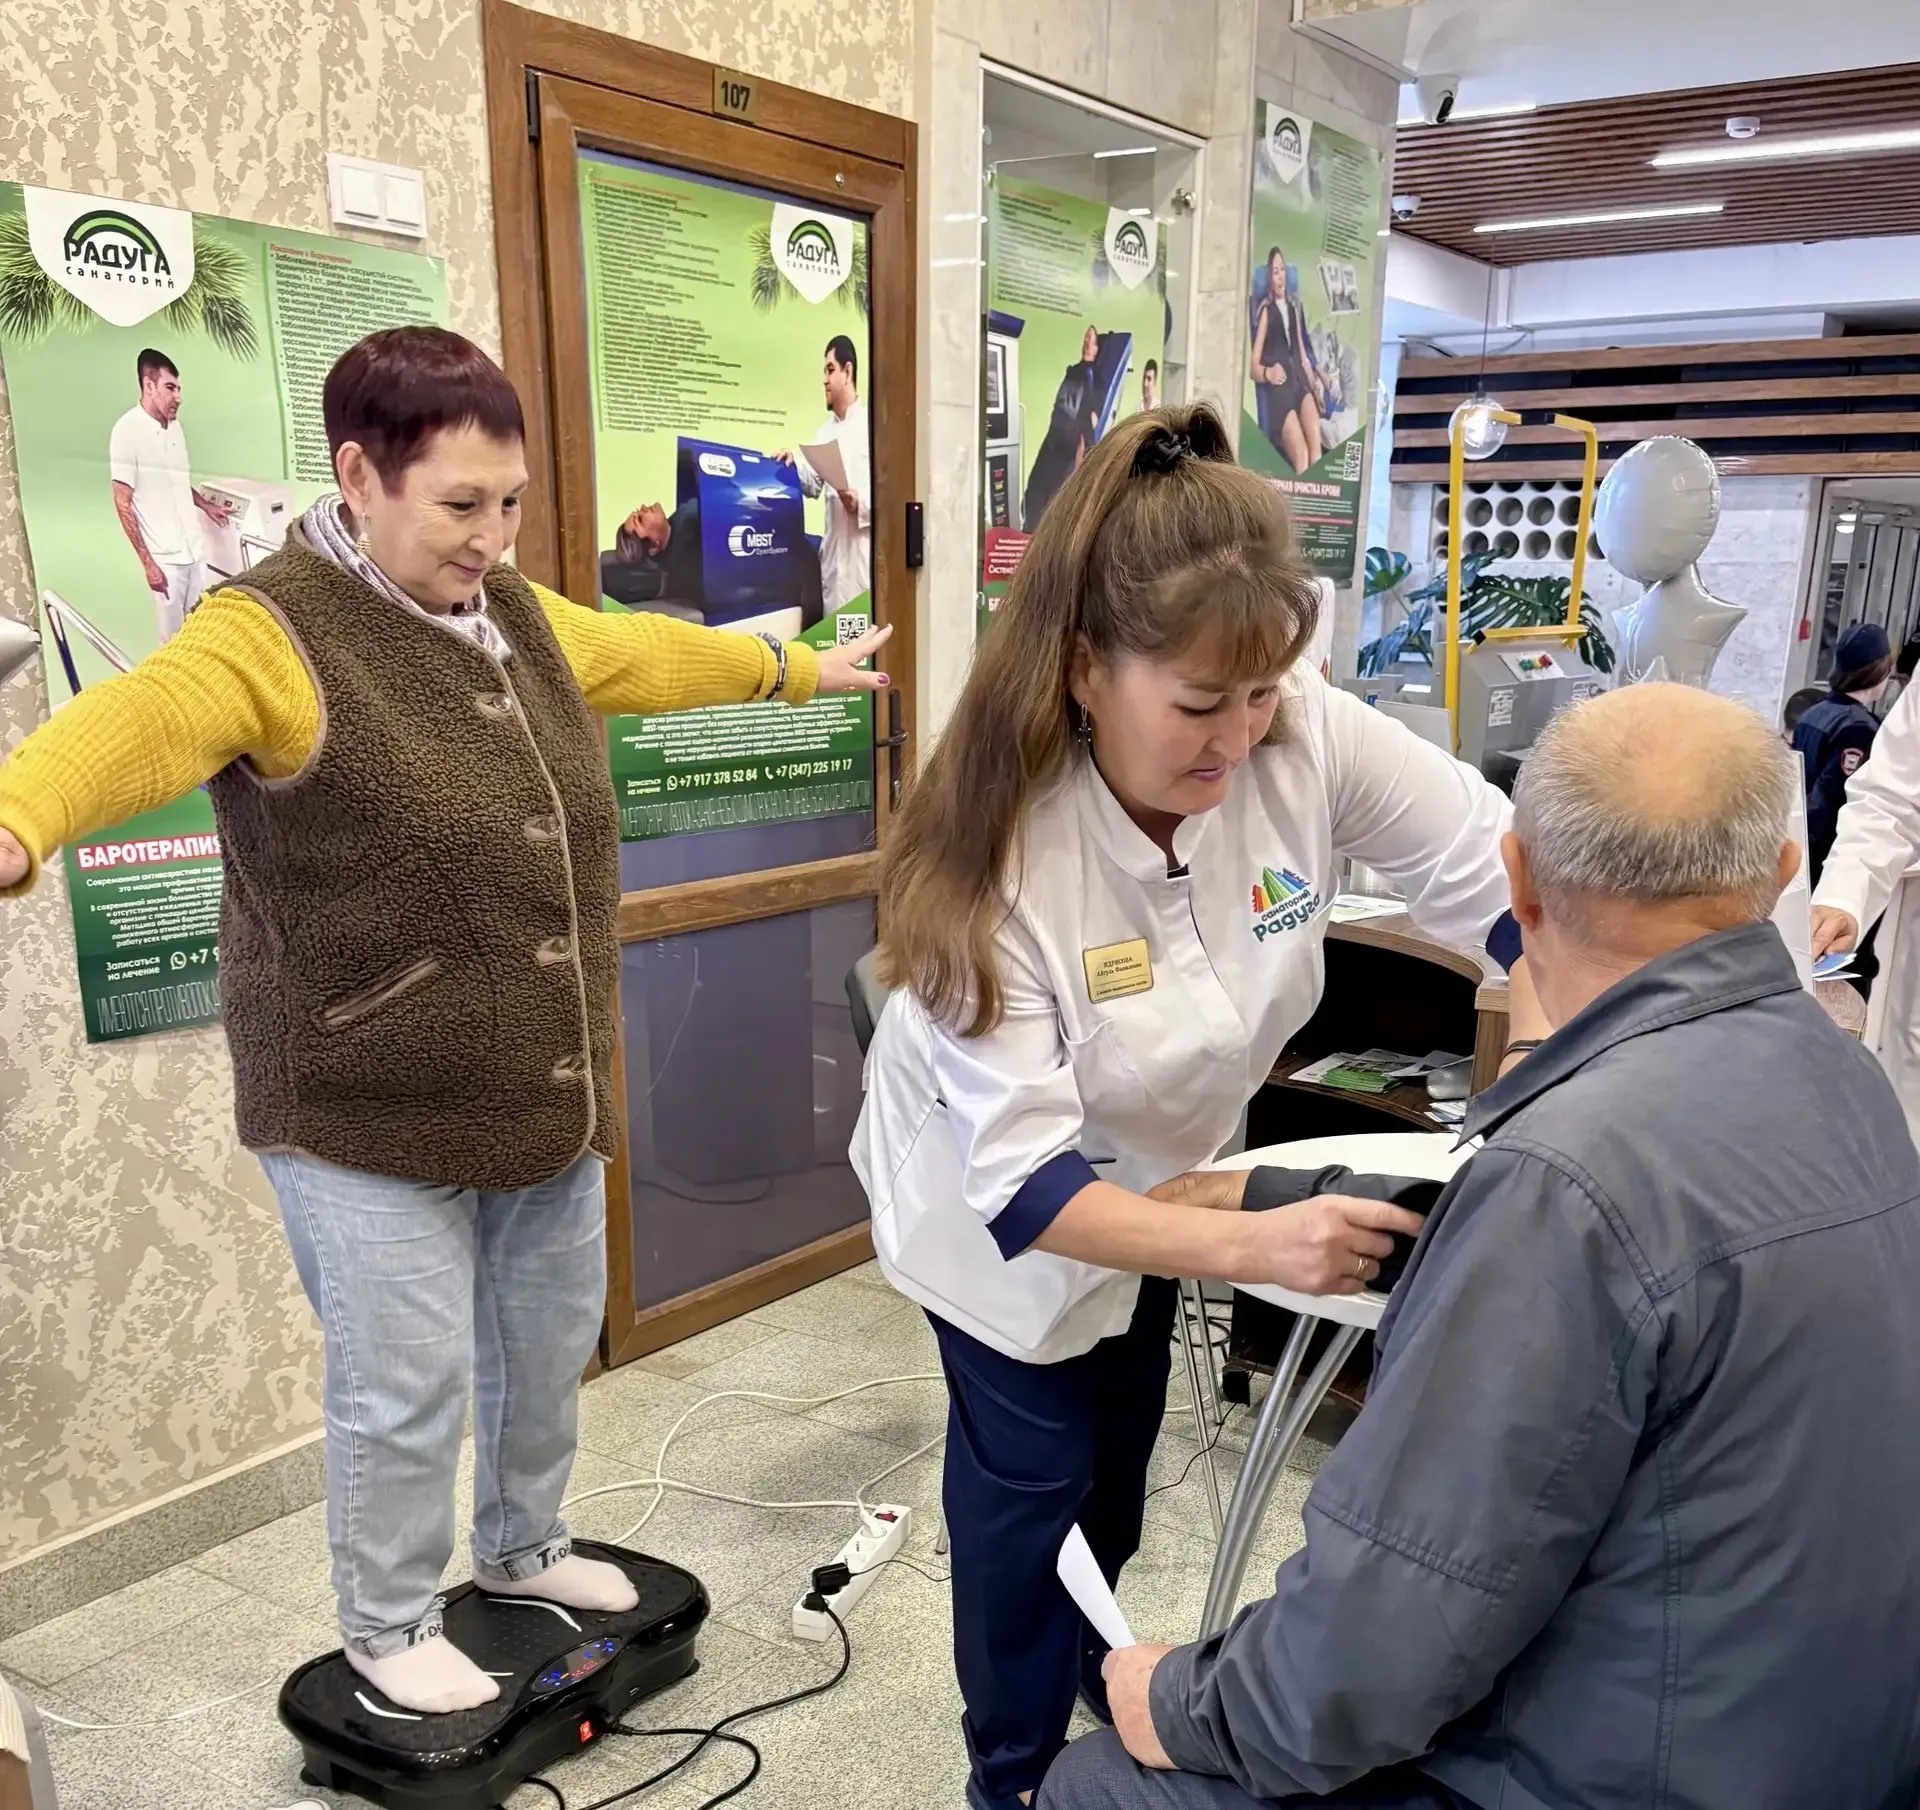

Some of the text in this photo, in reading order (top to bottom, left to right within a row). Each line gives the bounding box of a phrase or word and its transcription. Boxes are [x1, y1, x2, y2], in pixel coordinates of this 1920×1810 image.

[721, 80, 750, 112] 107
[64, 238, 171, 276] РАДУГА
[787, 240, 839, 267] РАДУГА
[1114, 240, 1148, 260] РАДУГА
[746, 533, 773, 548] MBST
[679, 767, 758, 787] +7 917 378 52 84
[775, 758, 853, 780] +7 (347) 225 19 17
[86, 874, 141, 888] Современная
[1261, 889, 1311, 922] санаторий
[106, 955, 160, 971] Записаться
[189, 948, 209, 964] +7
[107, 966, 160, 981] на лечение
